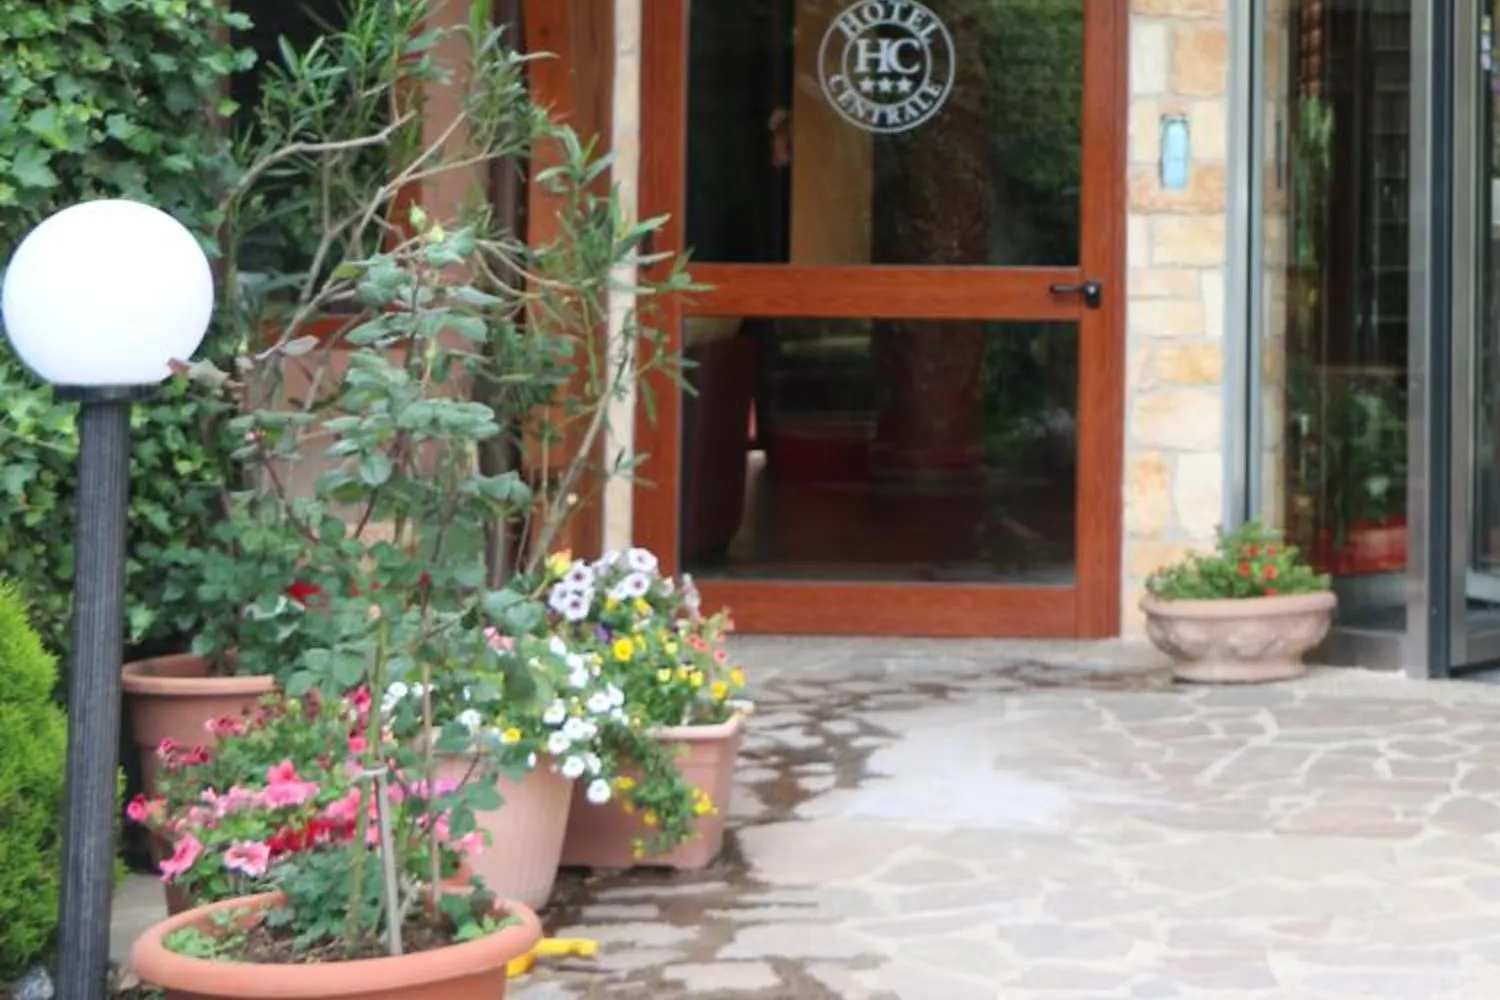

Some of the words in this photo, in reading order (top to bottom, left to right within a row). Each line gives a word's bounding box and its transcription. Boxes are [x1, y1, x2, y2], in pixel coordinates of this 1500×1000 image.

[836, 0, 941, 46] HOTEL
[853, 37, 921, 74] HC
[828, 73, 943, 126] CENTRALE
